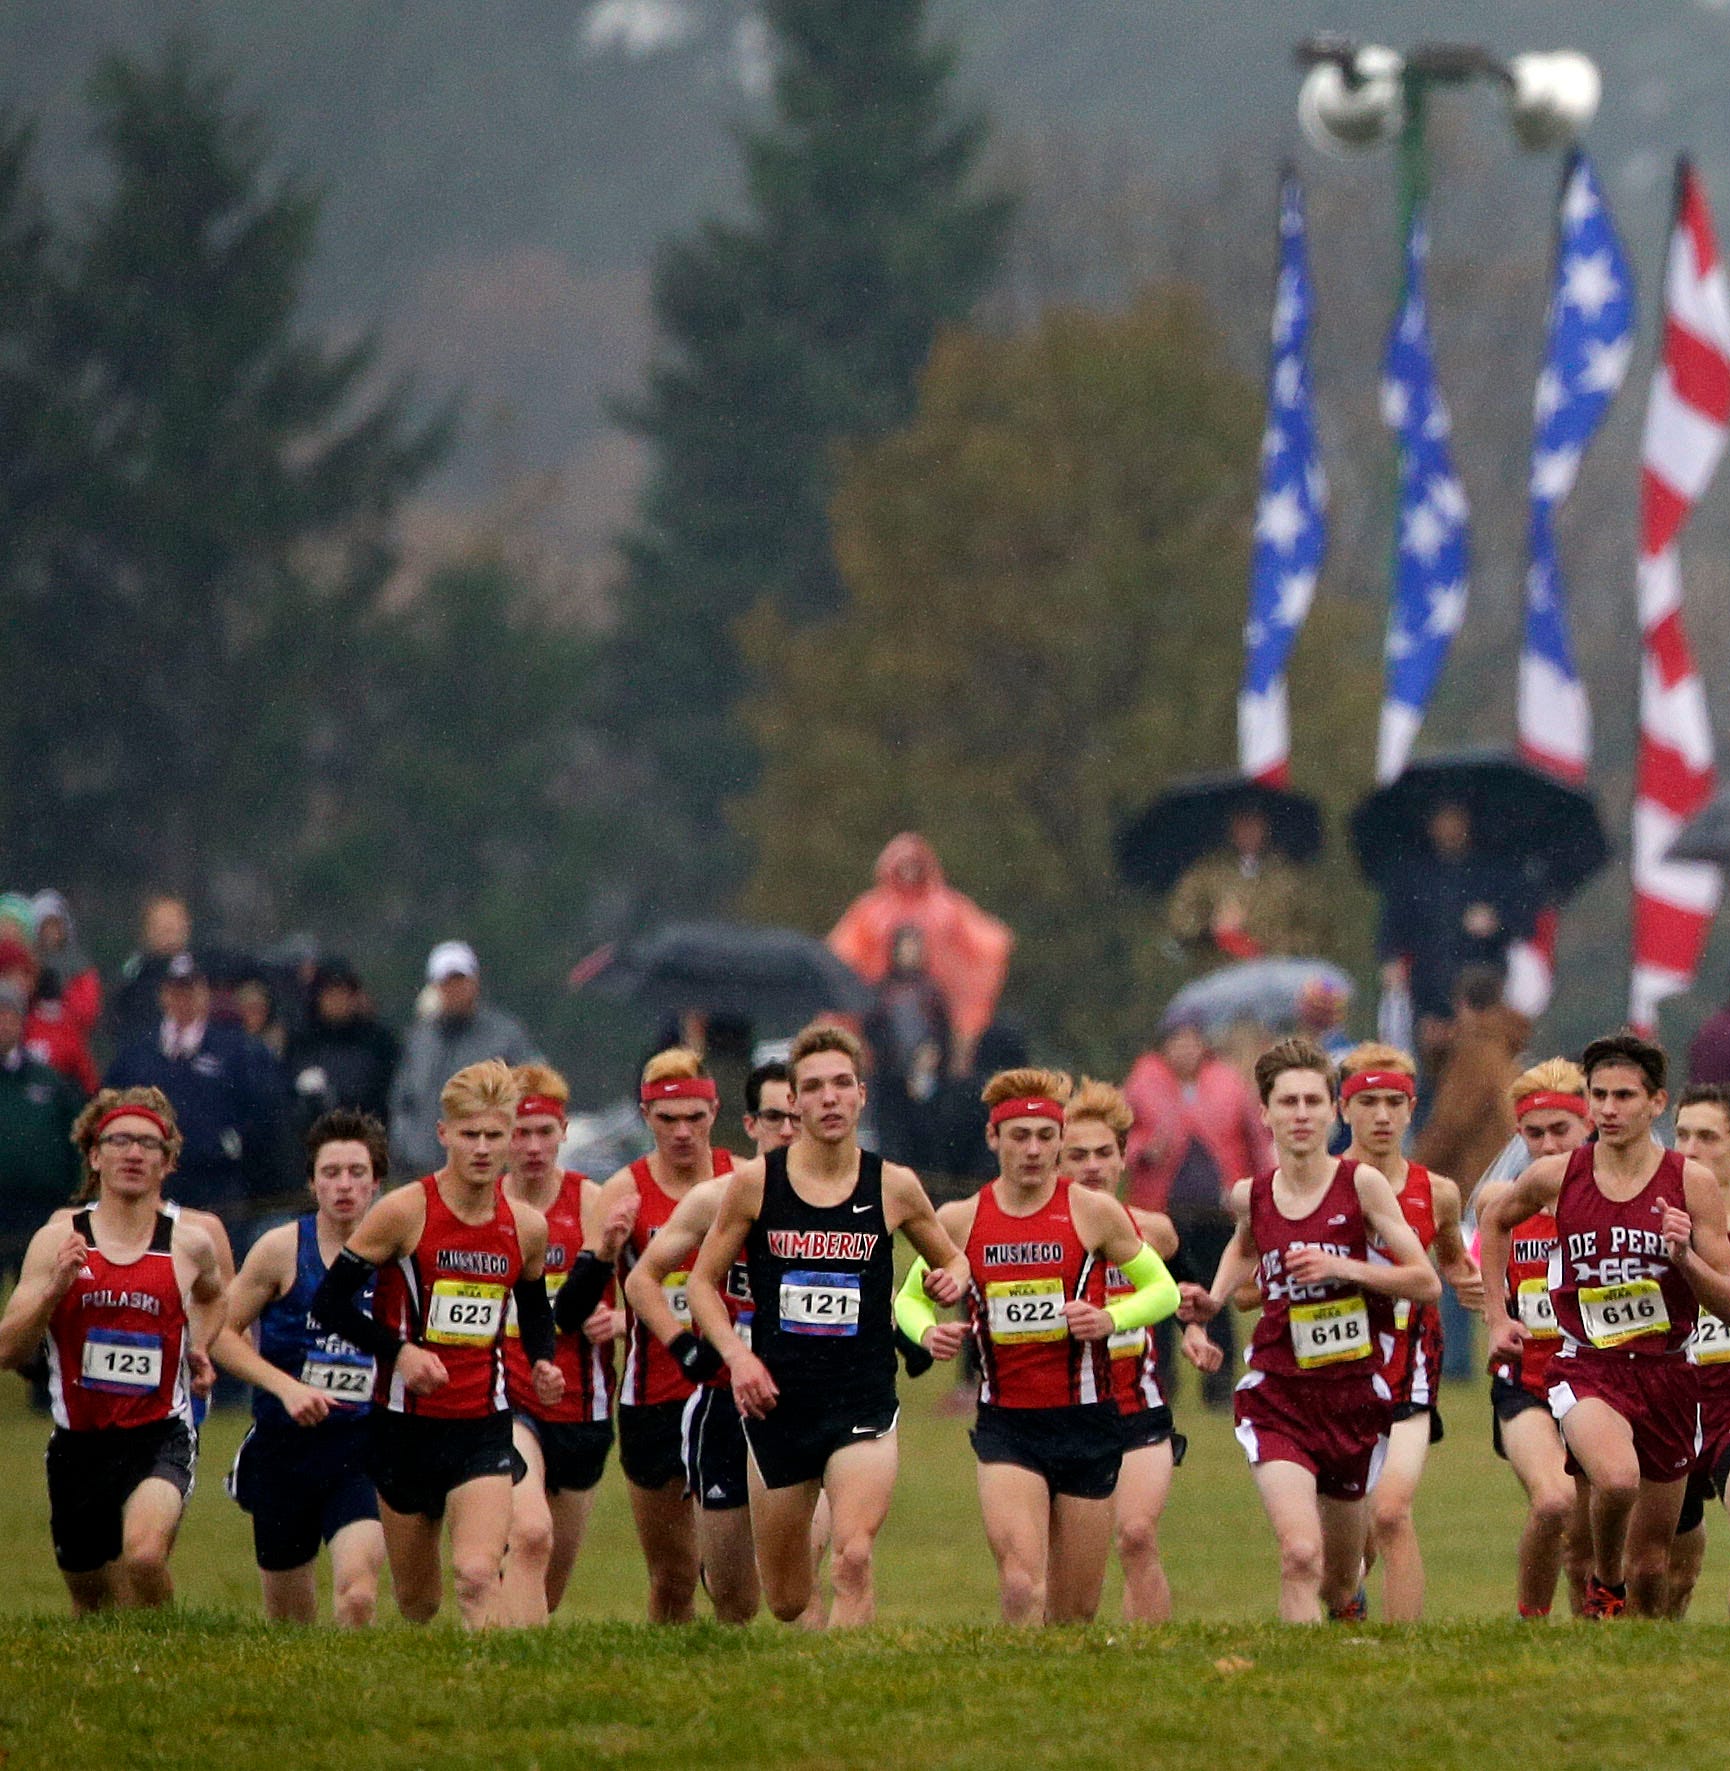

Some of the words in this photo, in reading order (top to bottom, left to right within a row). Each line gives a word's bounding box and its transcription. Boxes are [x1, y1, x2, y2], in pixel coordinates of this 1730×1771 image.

[767, 1230, 879, 1261] KIMBERLY
[984, 1242, 1064, 1267] MUSKEGO
[1514, 1237, 1558, 1264] MUS
[1568, 1231, 1597, 1261] DE
[1611, 1226, 1670, 1257] PERE
[437, 1249, 509, 1277] MUSKEGO
[1600, 1257, 1642, 1286] CC
[82, 1289, 160, 1317] PULASKI
[449, 1304, 492, 1325] 623
[801, 1293, 848, 1315] 121
[1006, 1302, 1056, 1322] 622
[1603, 1300, 1655, 1324] 616
[1312, 1321, 1360, 1345] 618
[105, 1352, 151, 1375] 123
[323, 1371, 368, 1393] 122
